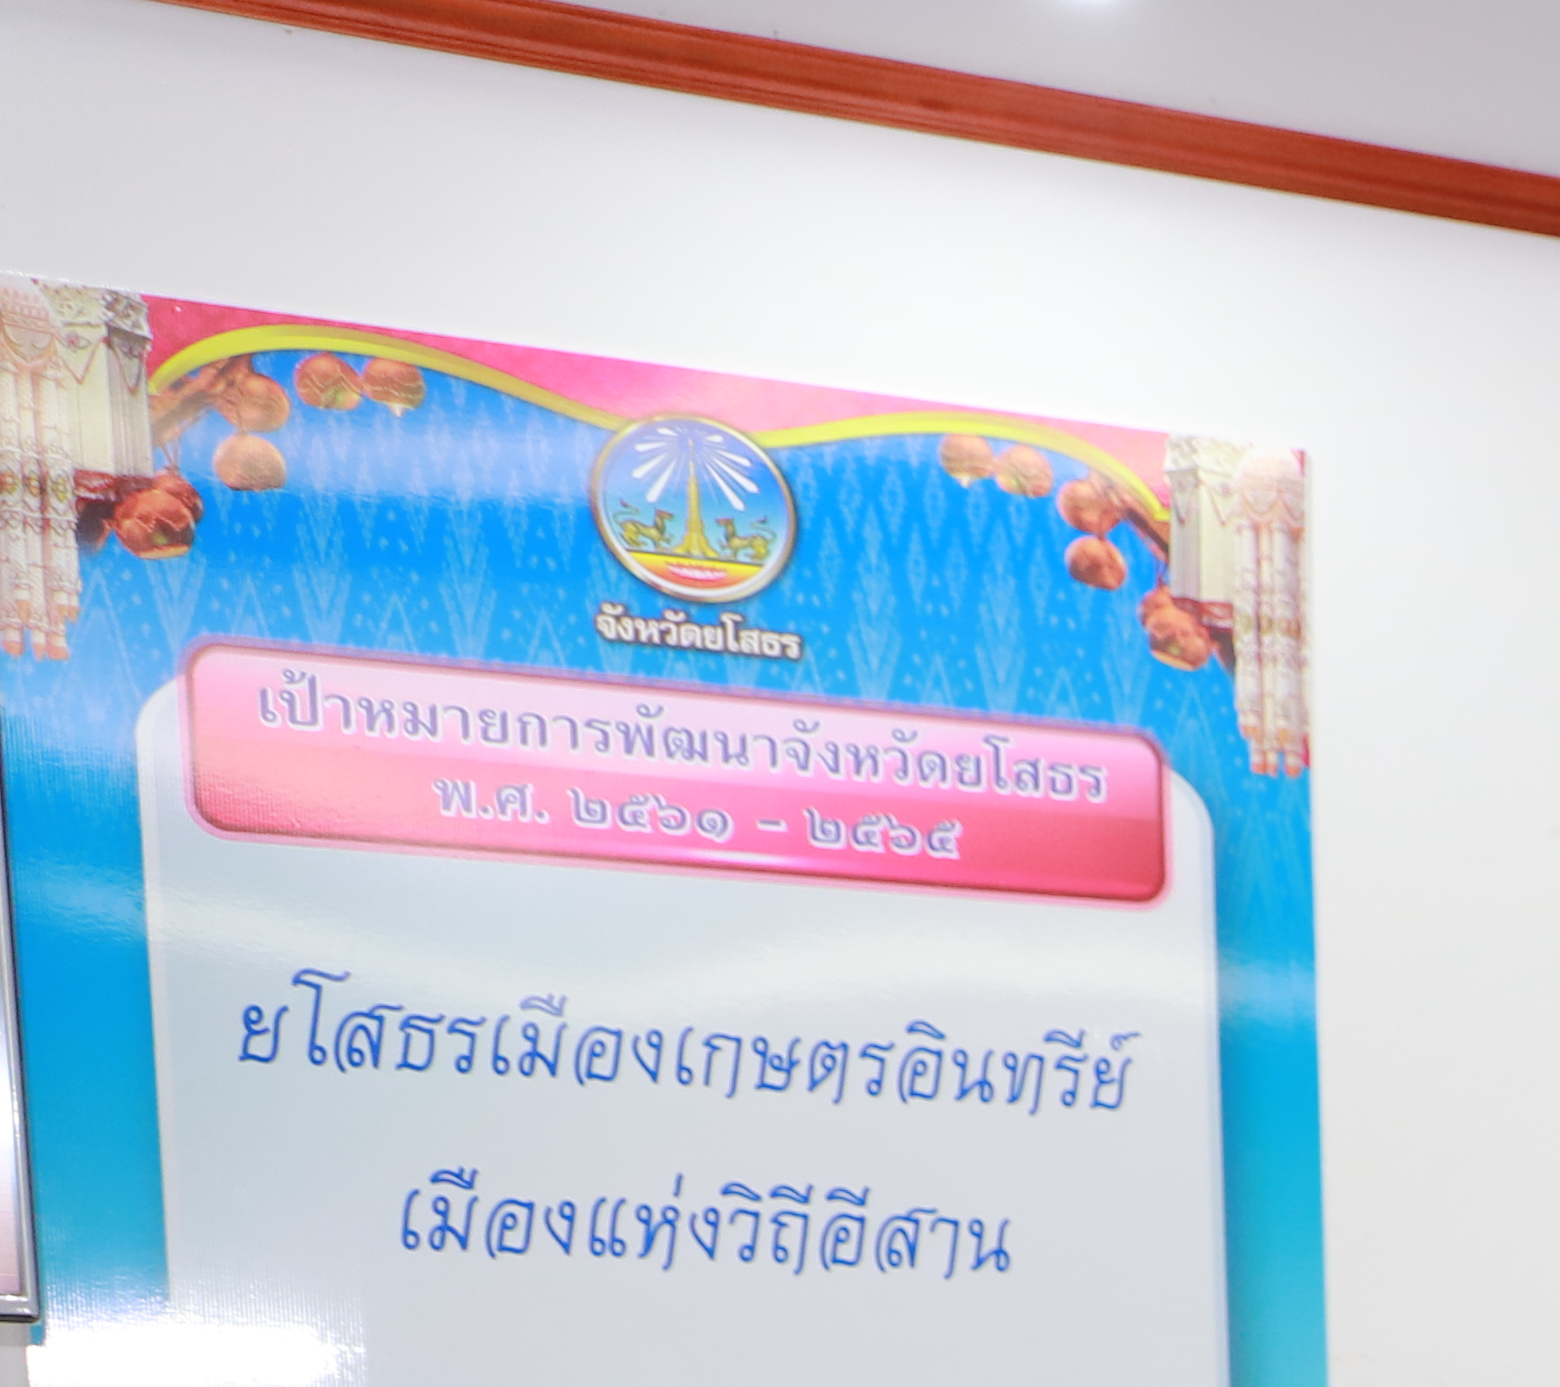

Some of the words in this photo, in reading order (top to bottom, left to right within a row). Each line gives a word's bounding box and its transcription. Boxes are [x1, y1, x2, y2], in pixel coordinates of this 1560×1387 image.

[596, 602, 803, 662] จังหวัดยโสธร
[258, 680, 1107, 804] เป้าหมายการพัฒนาจังหวัดยโสธร
[435, 772, 549, 827] พ.ศ.
[570, 787, 732, 844] ๒๕๖๑
[805, 805, 962, 863] ๒๕๖๕
[237, 970, 1141, 1114] ยโสธรเมืองเกษตรอินทรีย์
[400, 1166, 1012, 1278] เมืองแห่งวิถีอีสาน
